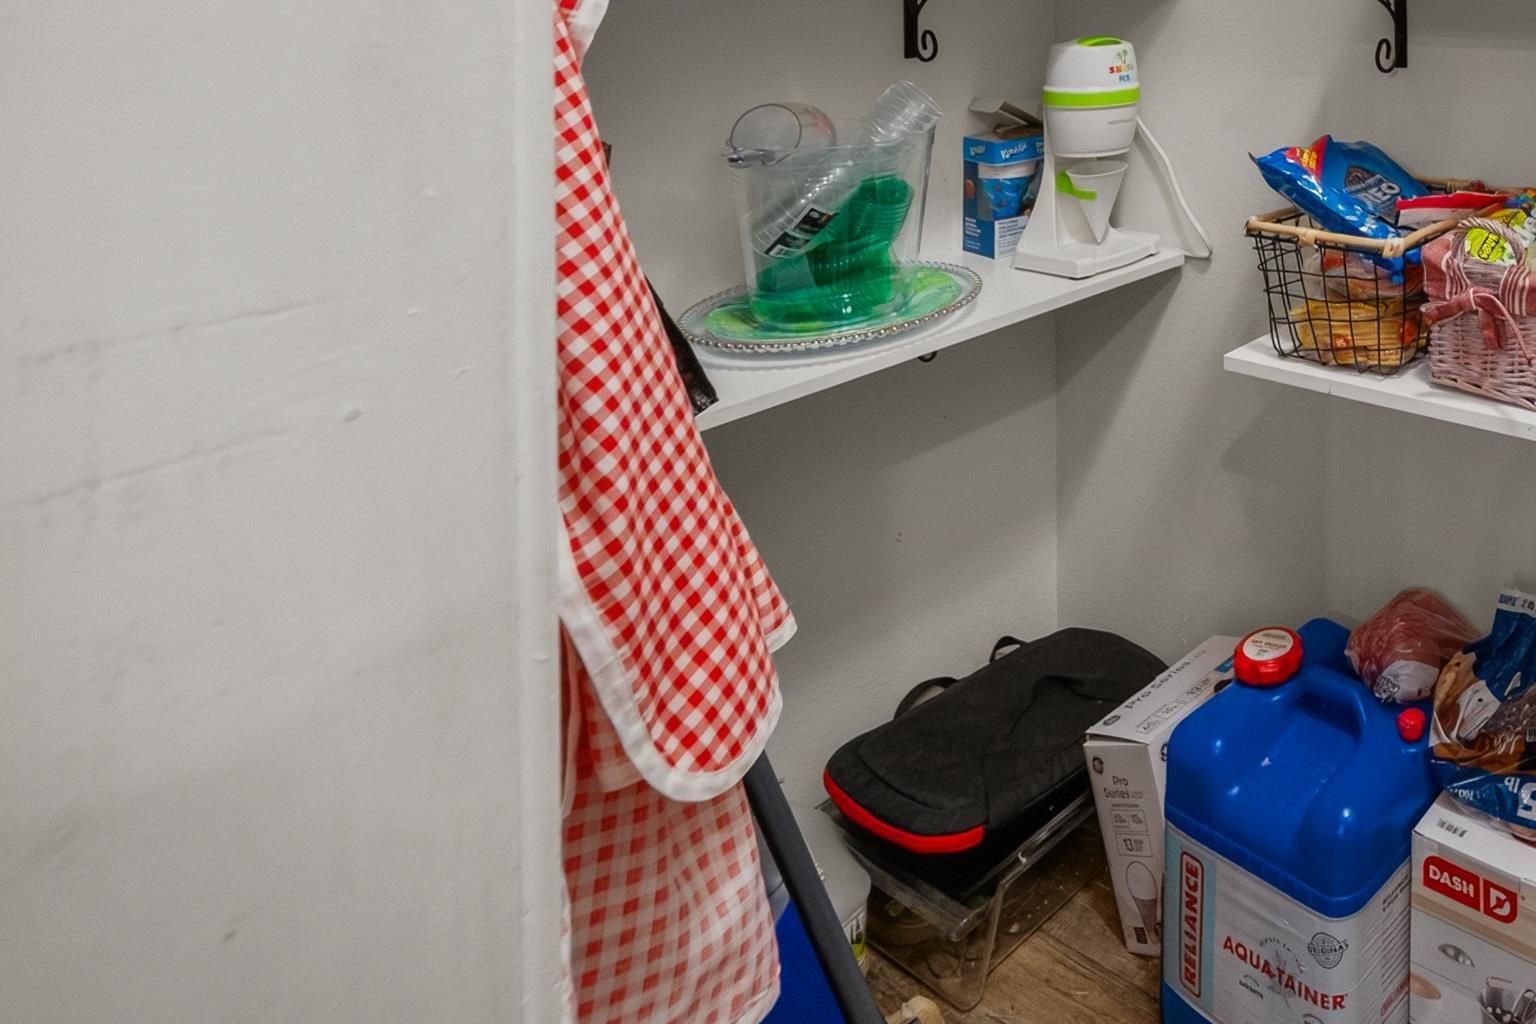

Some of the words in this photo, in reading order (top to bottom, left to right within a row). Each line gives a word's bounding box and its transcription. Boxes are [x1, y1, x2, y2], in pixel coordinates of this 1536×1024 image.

[1112, 776, 1129, 787] Pro
[1503, 776, 1520, 794] lb
[1103, 788, 1130, 800] Series
[1122, 837, 1133, 852] 13
[1428, 864, 1475, 899] DASH
[1183, 861, 1199, 988] RELIANCE
[1222, 935, 1349, 1011] AQUA-TAINER
